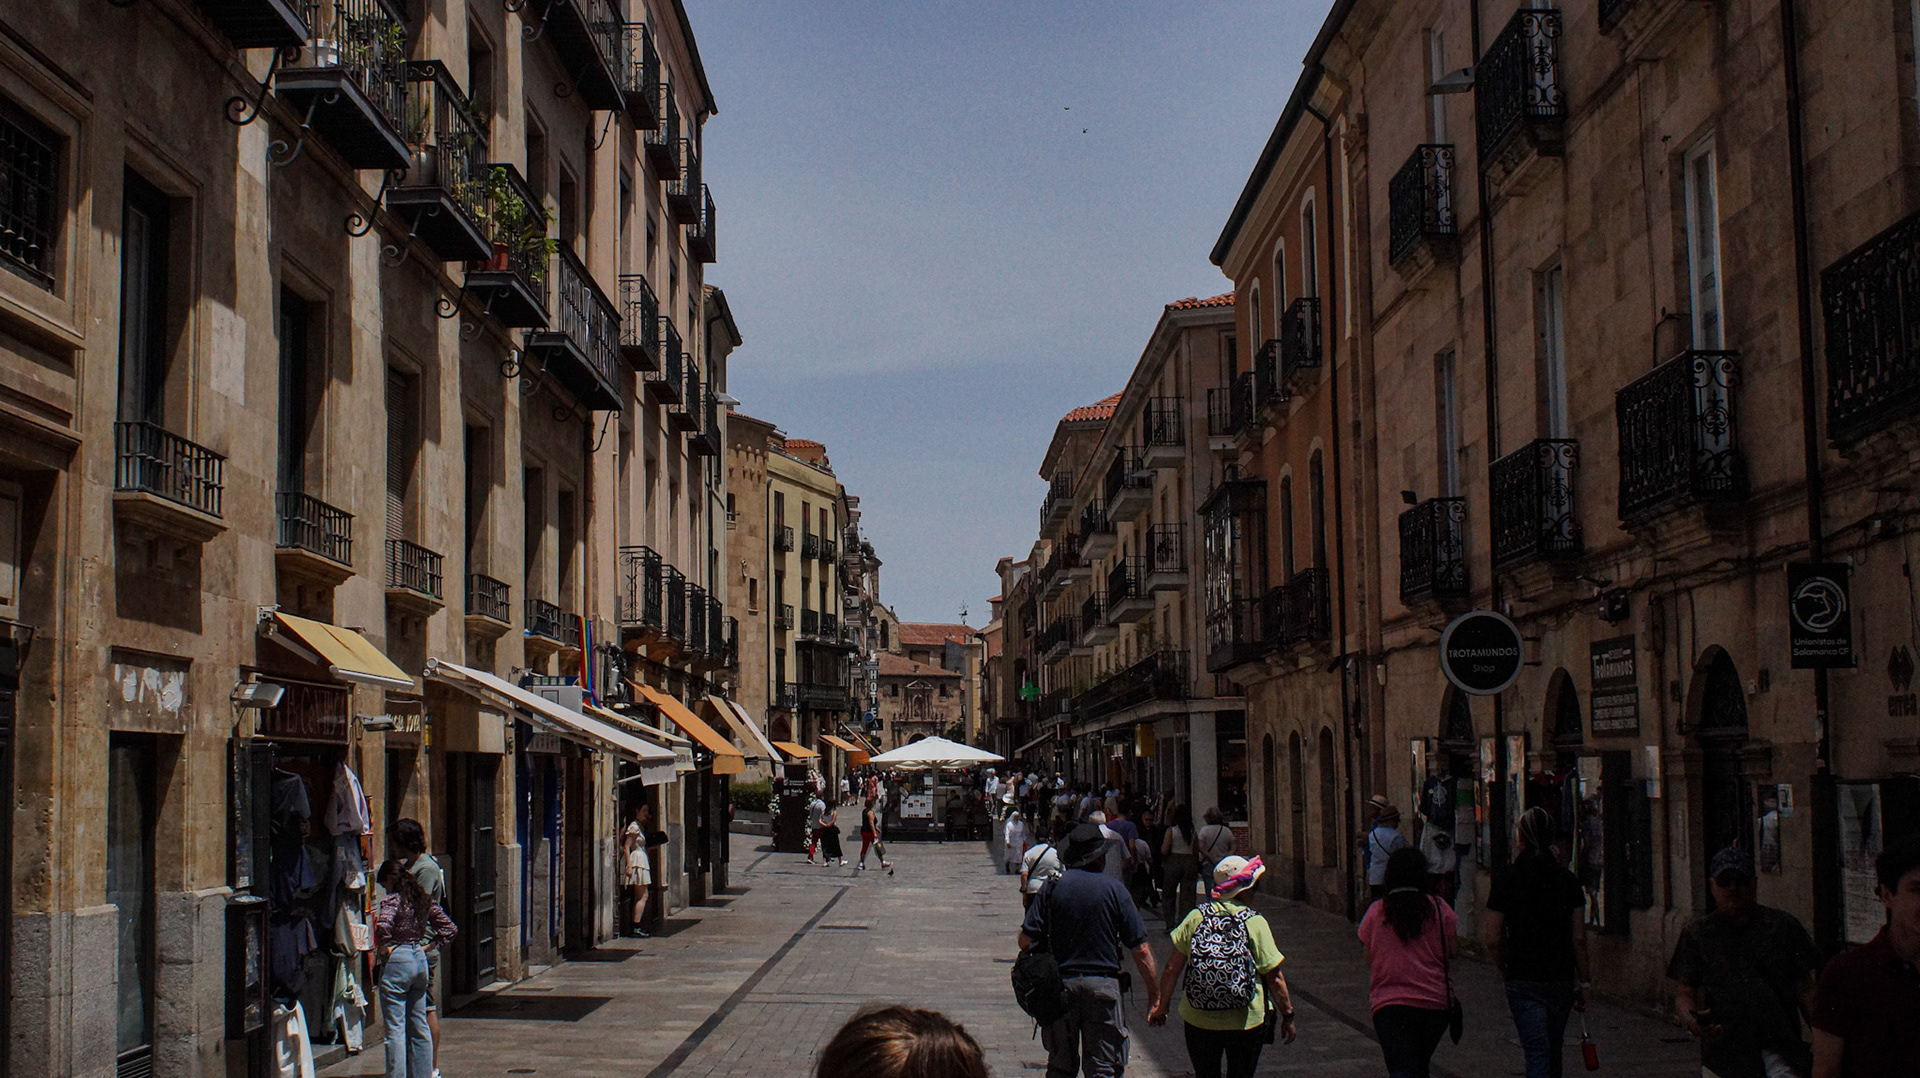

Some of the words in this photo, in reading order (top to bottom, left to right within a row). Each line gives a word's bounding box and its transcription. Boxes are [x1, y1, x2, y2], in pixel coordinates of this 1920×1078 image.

[1836, 637, 1847, 646] de
[1448, 647, 1518, 658] TROTAMUNDOS
[1793, 647, 1837, 656] Salamanca
[1838, 647, 1850, 655] CF
[1473, 664, 1495, 674] Shop
